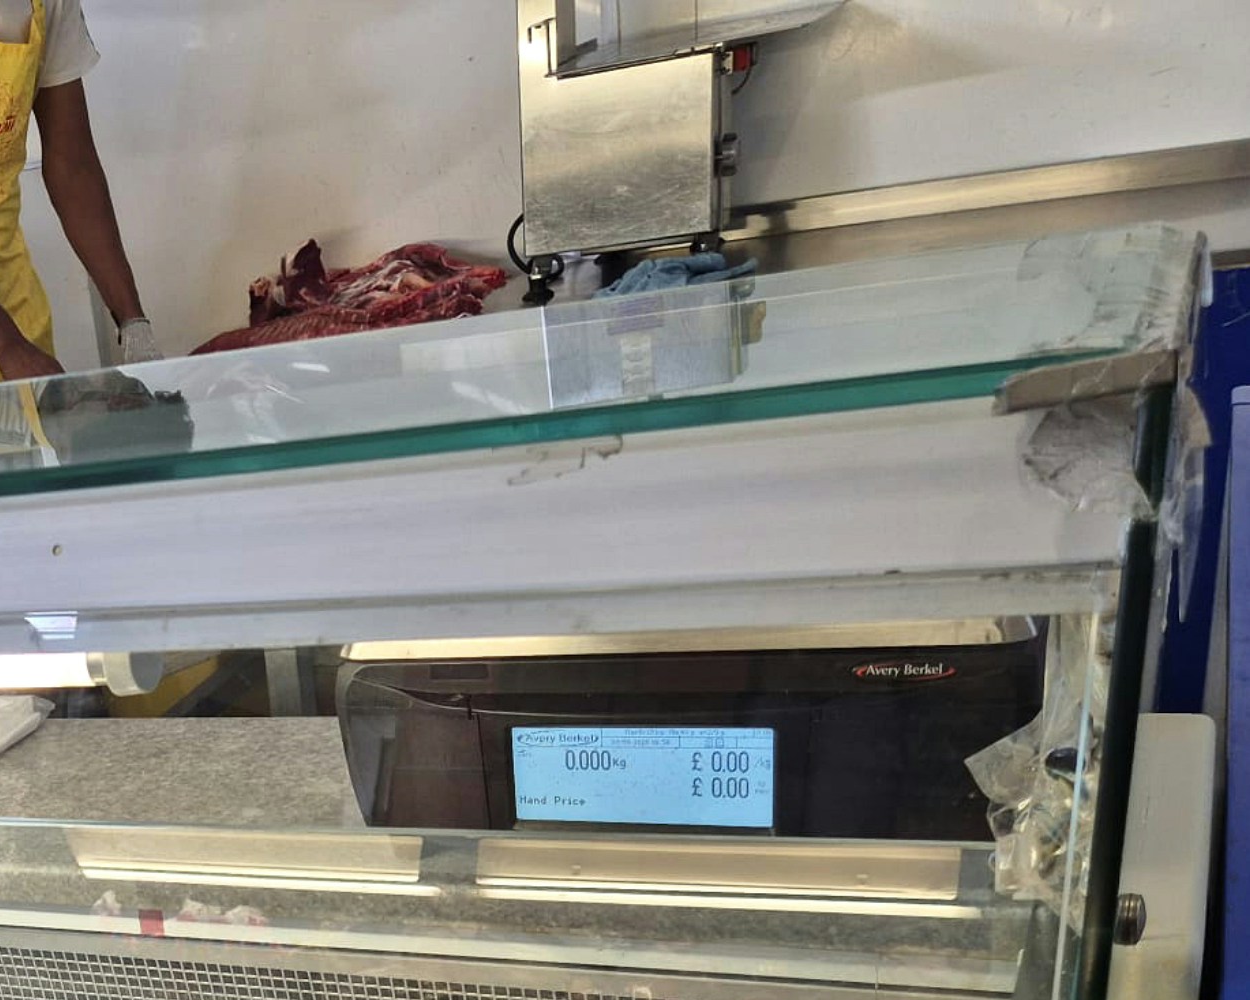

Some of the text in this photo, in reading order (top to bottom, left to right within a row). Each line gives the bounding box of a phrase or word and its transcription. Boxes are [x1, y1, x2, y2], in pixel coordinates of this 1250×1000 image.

[865, 662, 943, 677] Avery Berkel
[565, 750, 611, 771] 0.000
[691, 751, 703, 771] £
[711, 750, 749, 774] 0.00
[691, 777, 703, 797] £
[711, 776, 749, 799] 0.00
[519, 794, 586, 807] Hand Price
